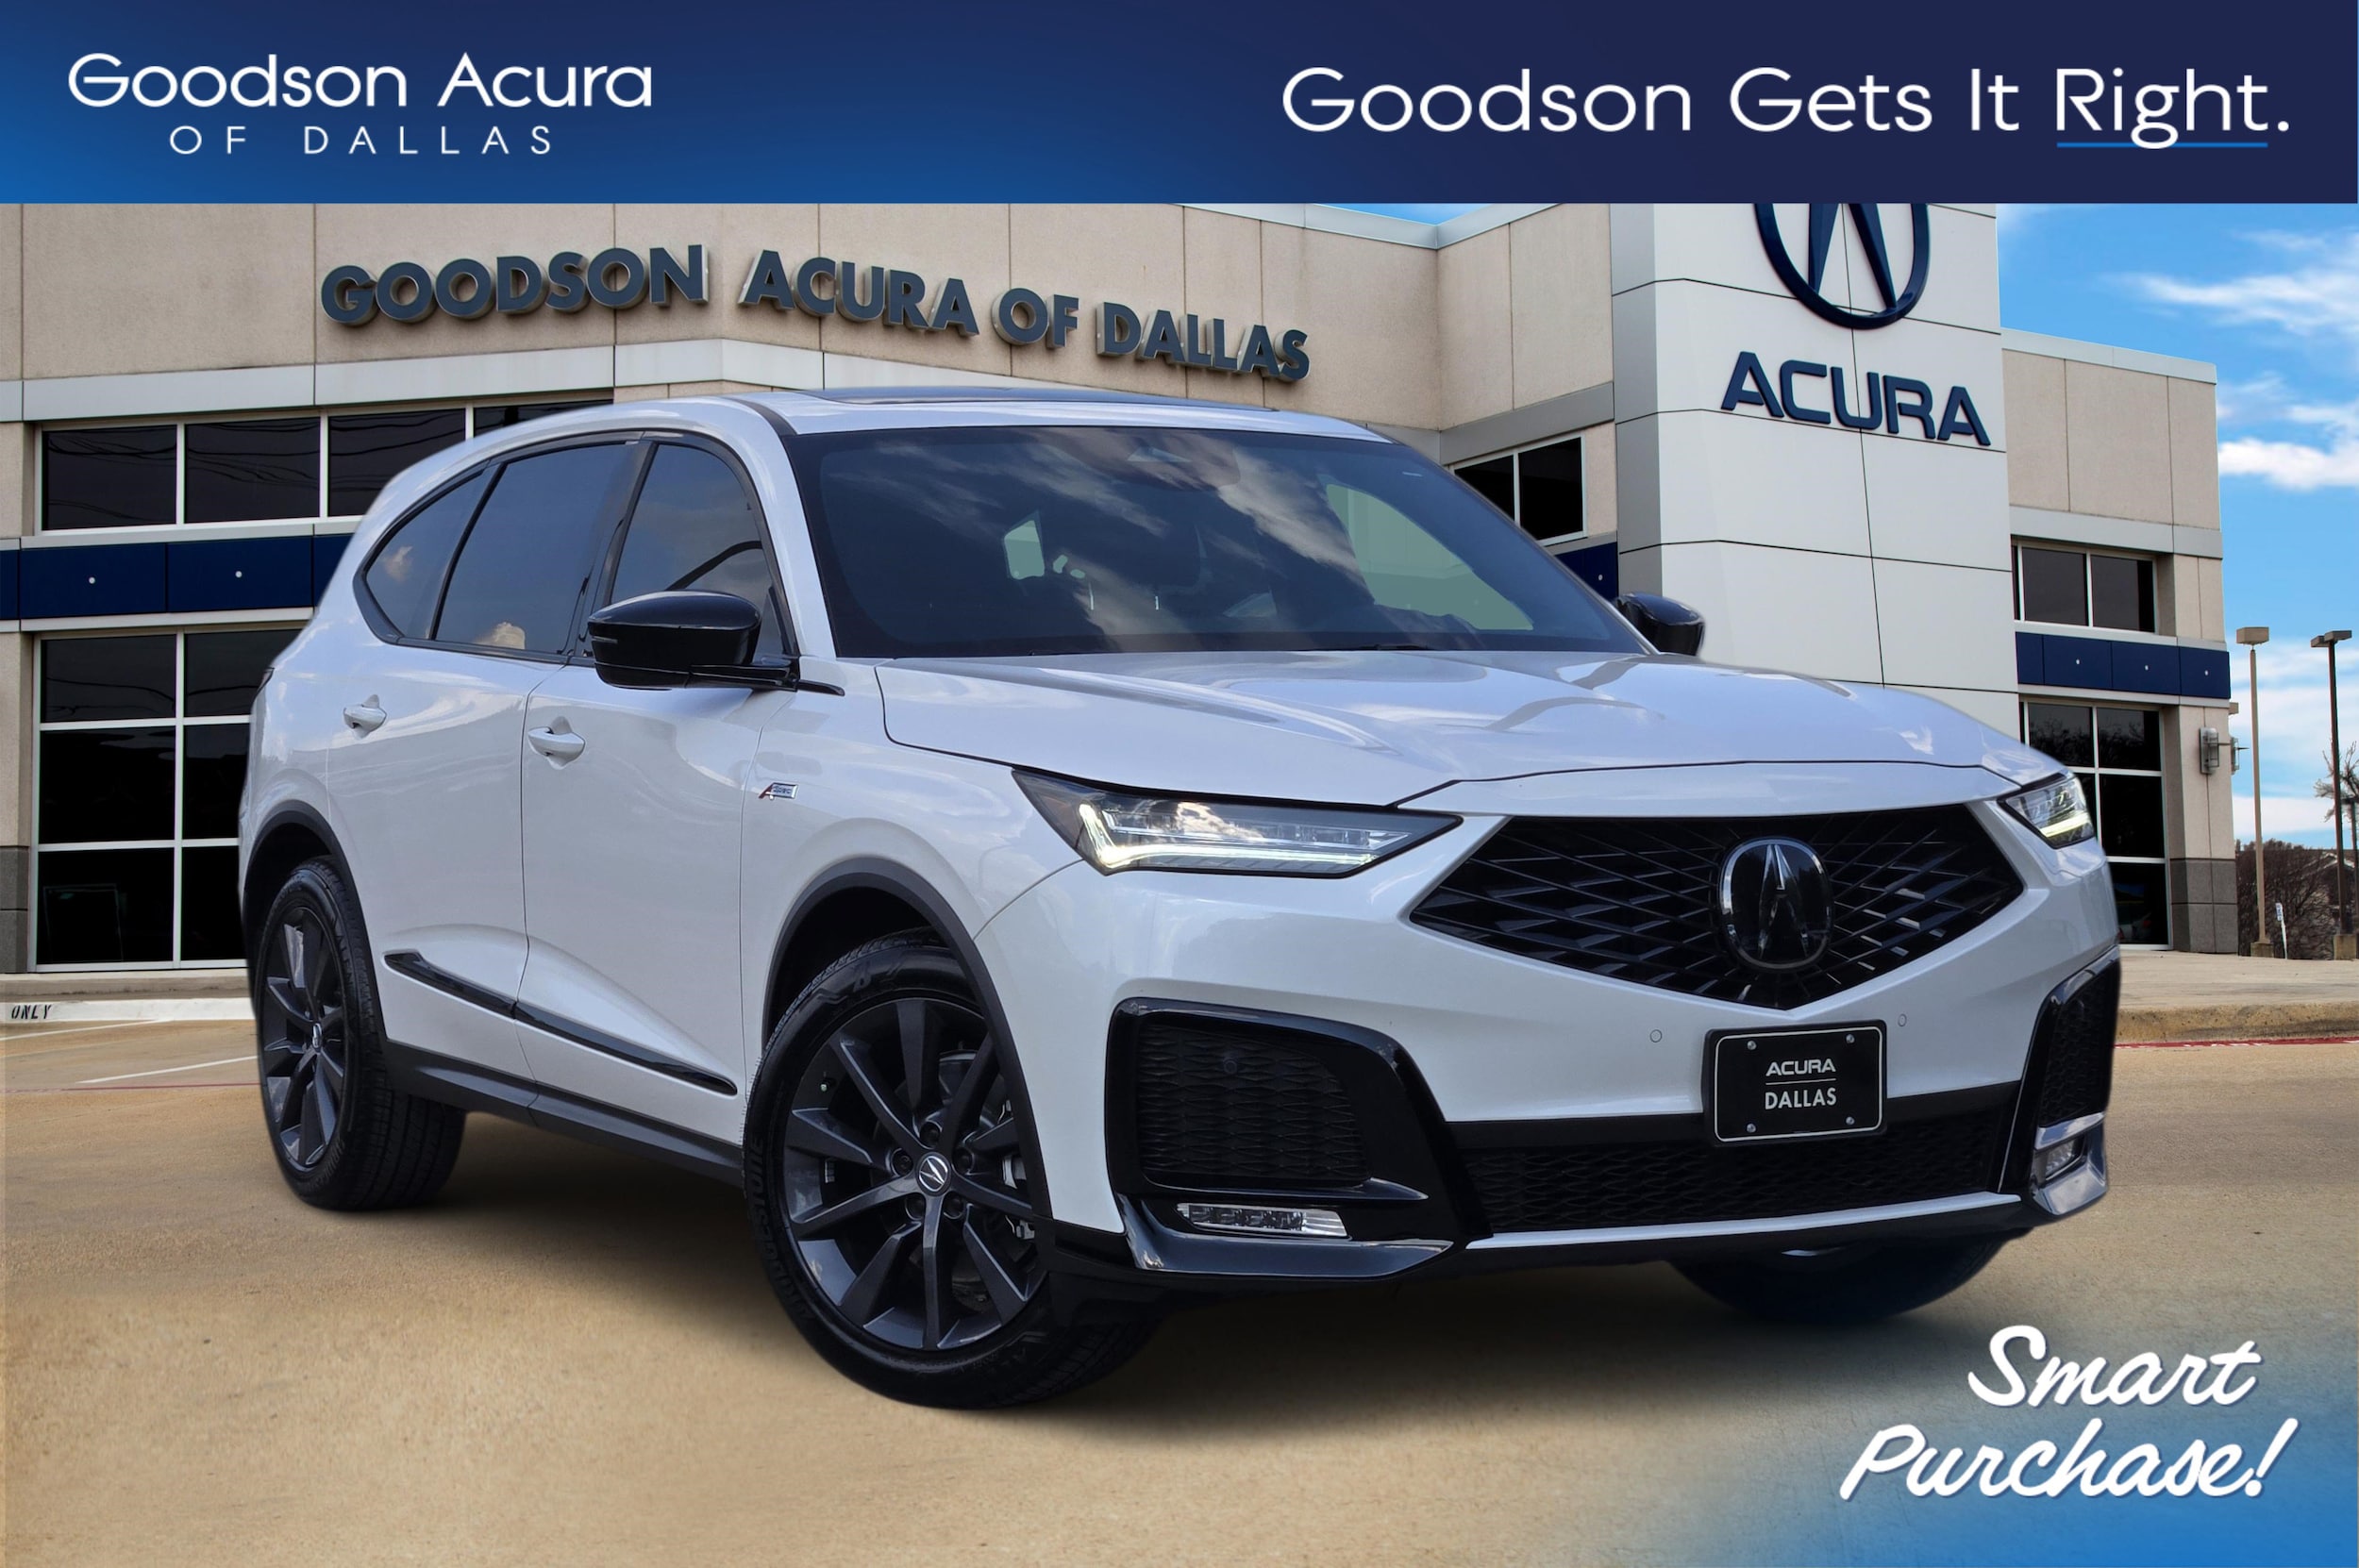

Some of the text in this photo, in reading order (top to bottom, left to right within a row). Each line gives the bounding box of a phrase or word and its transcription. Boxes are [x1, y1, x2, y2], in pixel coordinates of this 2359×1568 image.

[321, 243, 1311, 381] GOODSON ACURA OF DALLAS
[1719, 350, 1991, 447] ACURA
[10, 1004, 52, 1020] ONLY
[1765, 1058, 1837, 1077] ACURA
[1764, 1087, 1838, 1110] DALLAS
